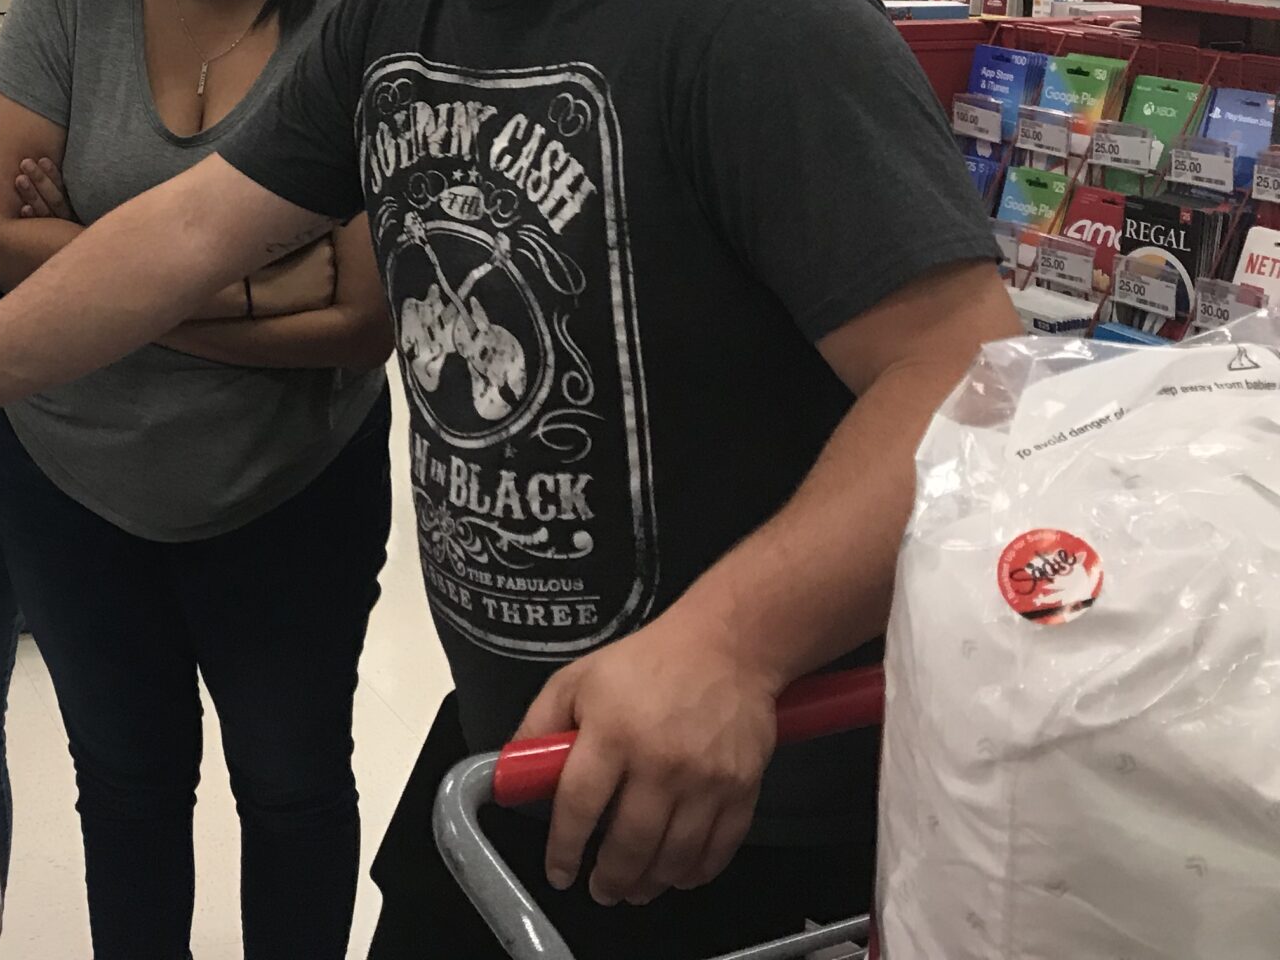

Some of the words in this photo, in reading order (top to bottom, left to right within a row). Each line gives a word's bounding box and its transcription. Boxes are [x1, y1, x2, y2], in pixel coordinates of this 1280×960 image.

[981, 67, 995, 78] App
[996, 70, 1014, 81] Store
[1045, 86, 1080, 106] Google
[1021, 129, 1043, 141] 50.00
[1095, 143, 1119, 155] 25.00
[489, 113, 598, 235] CASH
[1174, 160, 1202, 174] 25.00
[1004, 196, 1038, 217] Google
[1125, 218, 1192, 252] REGAL
[1040, 257, 1065, 271] 25.00
[1119, 280, 1146, 296] 25.00
[1200, 303, 1230, 321] 30.00
[1180, 382, 1214, 394] away
[1214, 381, 1244, 390] from
[1015, 447, 1032, 461] To
[1033, 432, 1068, 451] avoid
[1069, 414, 1114, 438] danger
[449, 455, 596, 522] BLACK
[496, 575, 585, 592] FABULOUS
[482, 596, 599, 627] THREE
